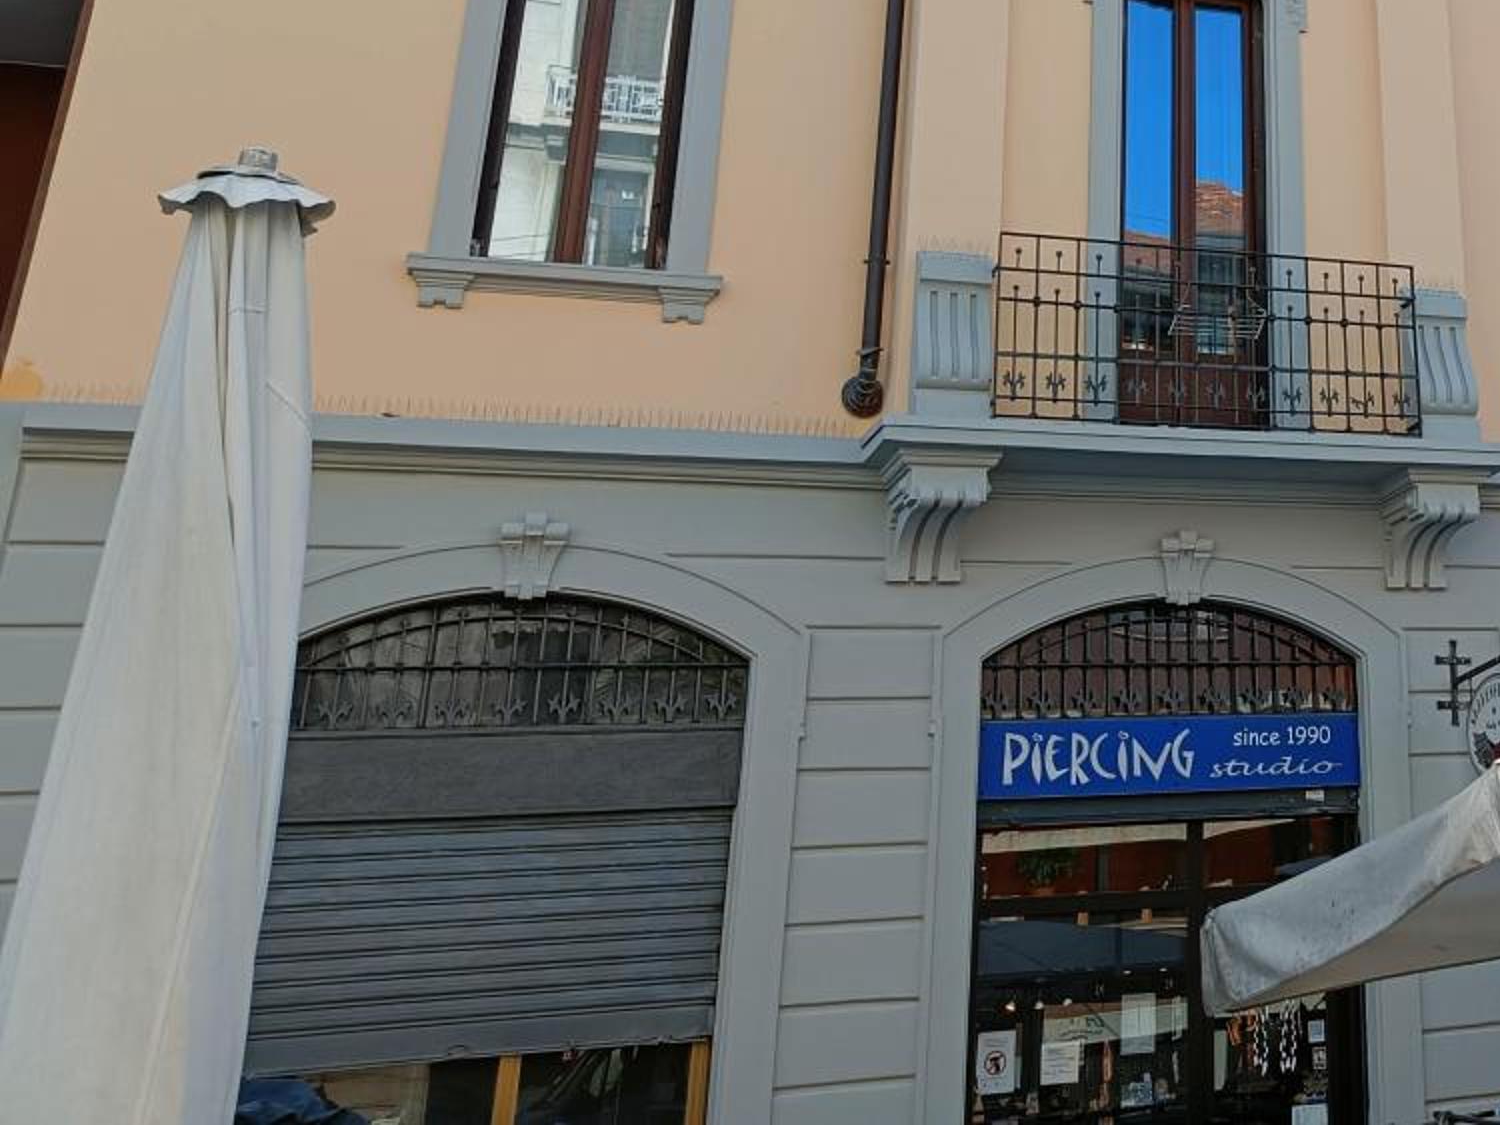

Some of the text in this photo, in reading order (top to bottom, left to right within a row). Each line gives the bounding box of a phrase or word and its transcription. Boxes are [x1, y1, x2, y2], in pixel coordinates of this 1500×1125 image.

[1232, 726, 1332, 746] since 1990
[1209, 754, 1343, 778] studio
